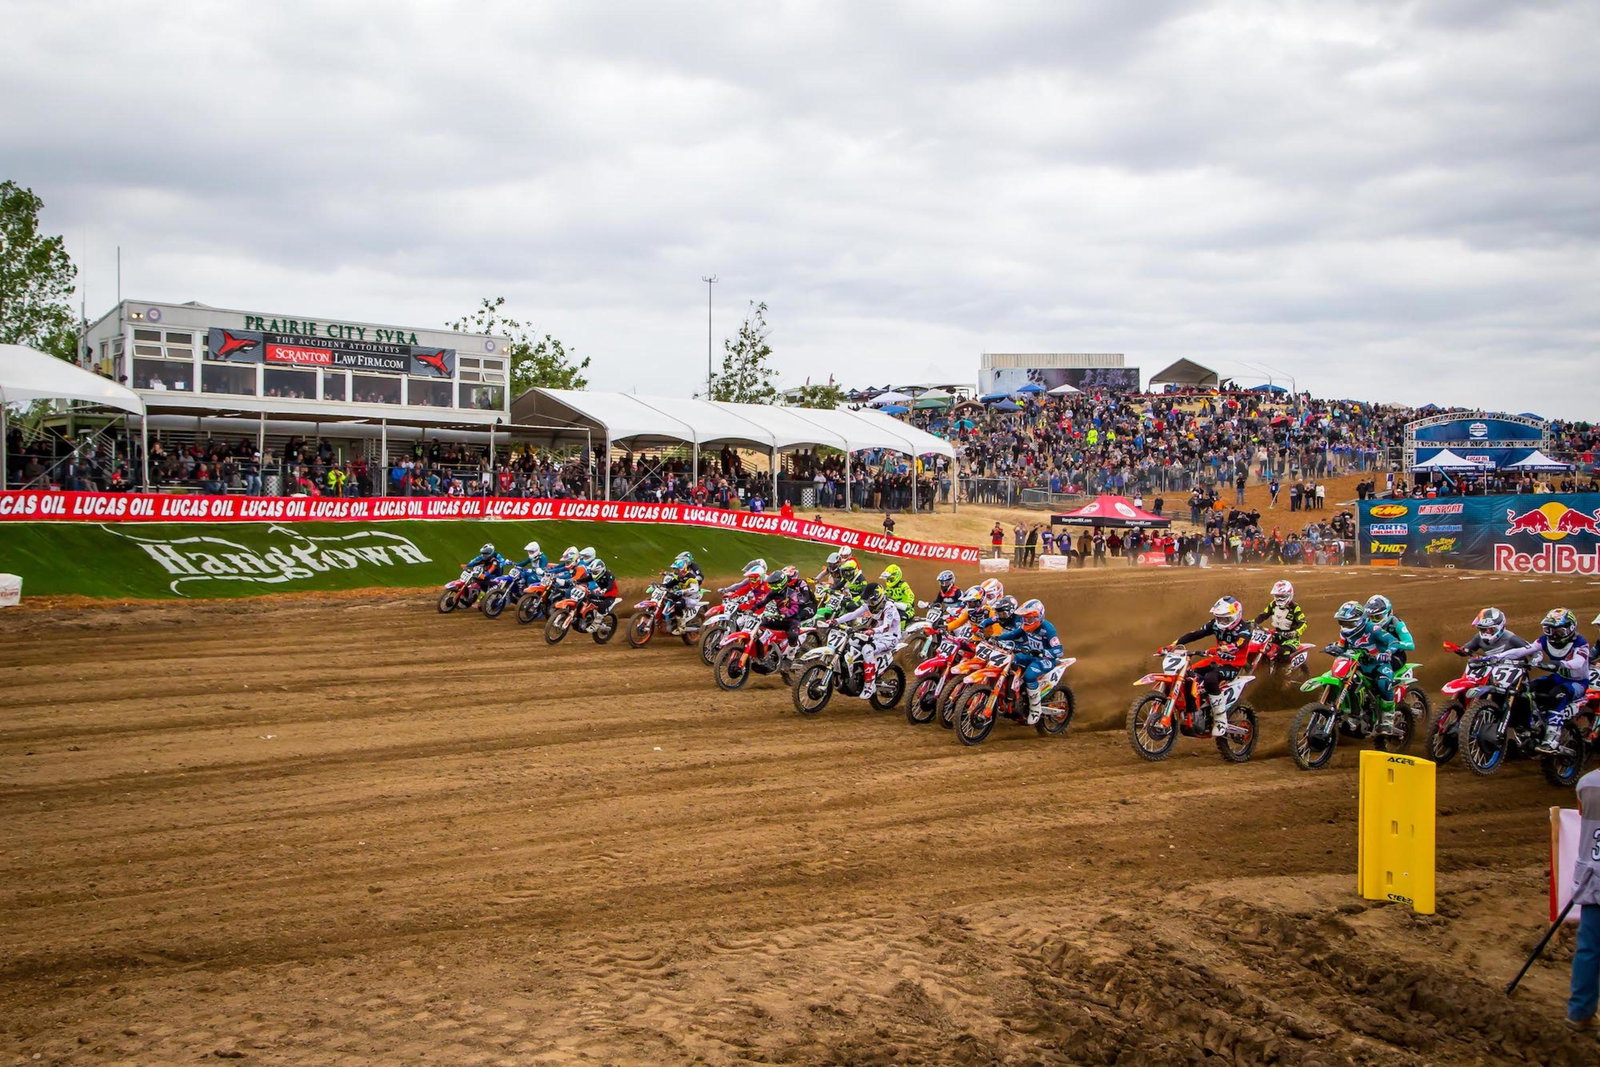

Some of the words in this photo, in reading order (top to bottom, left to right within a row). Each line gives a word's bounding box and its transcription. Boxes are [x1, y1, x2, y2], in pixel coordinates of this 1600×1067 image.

[245, 315, 317, 336] PRAIRIE
[326, 324, 367, 341] CITY
[376, 329, 419, 346] SVRA
[276, 336, 295, 344] THE
[299, 338, 346, 349] ACCIDENT
[349, 343, 400, 354] ATTORNEYS
[275, 348, 330, 363] SCRANTON
[0, 495, 37, 514] CAS
[41, 495, 66, 514] OIL
[73, 496, 126, 516] LUCAS
[130, 498, 155, 517] OIL
[161, 498, 208, 516] LUCAS
[211, 499, 235, 517] OIL
[241, 500, 284, 517] LUCAS
[286, 500, 306, 517] OIL
[309, 500, 350, 517] LUCAS
[350, 501, 369, 517] OIL
[374, 500, 406, 517] LUCAS
[407, 500, 423, 515] OIL
[427, 500, 459, 515] LUCAS
[462, 500, 480, 514] OIL
[485, 501, 531, 516] LUCAS
[532, 501, 553, 516] OIL
[559, 503, 600, 518] LUCAS
[601, 504, 619, 518] OIL
[623, 505, 659, 520] LUCAS
[661, 506, 679, 520] OIL
[683, 508, 719, 523] LUCAS
[720, 513, 738, 527] OIL
[741, 514, 778, 532] LUCAS
[780, 518, 798, 533] OIL
[802, 523, 840, 540] LUCAS
[840, 530, 859, 545] OIL
[863, 534, 902, 552] LUCAS
[902, 541, 921, 556] OIL
[919, 543, 960, 560] LUCAS
[961, 548, 978, 562] OIL
[138, 538, 433, 581] Hangtown
[1494, 543, 1553, 573] Red
[829, 634, 843, 647] 21
[941, 642, 955, 656] 94
[876, 654, 889, 670] 21
[990, 654, 1008, 666] 4
[1164, 657, 1182, 672] 2
[1334, 660, 1348, 673] 1
[1050, 672, 1058, 682] 4
[1495, 667, 1521, 683] 51
[1223, 688, 1236, 704] 2
